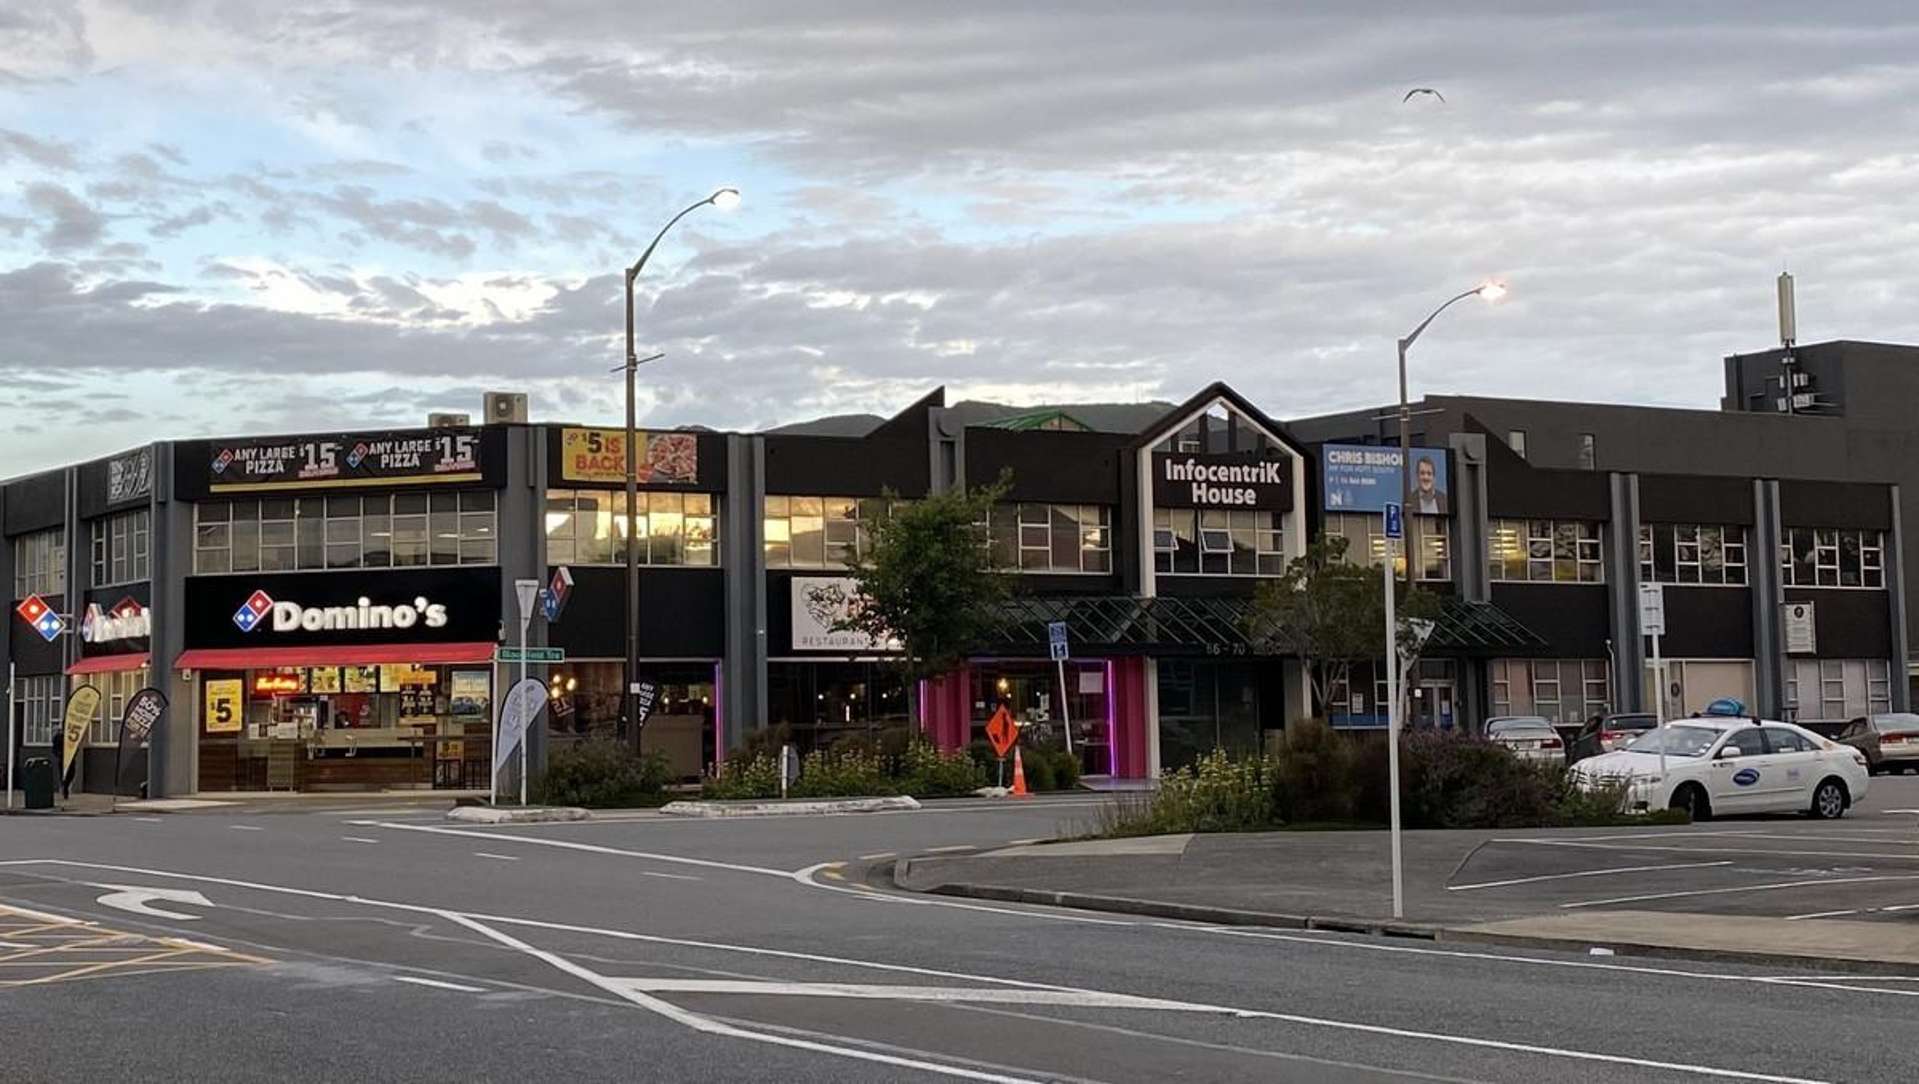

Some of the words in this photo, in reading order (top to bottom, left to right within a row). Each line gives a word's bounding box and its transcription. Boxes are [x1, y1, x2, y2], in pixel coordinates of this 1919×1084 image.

[235, 449, 257, 460] ANY
[260, 446, 295, 459] LARGE
[369, 442, 392, 455] ANY
[395, 440, 431, 453] LARGE
[605, 439, 621, 454] IS
[381, 454, 420, 468] PIZZA
[576, 454, 625, 471] BACK
[1328, 450, 1363, 464] CHRIS
[1365, 452, 1404, 466] BISHO
[246, 460, 284, 474] PIZZA
[1165, 458, 1281, 483] InfocentriK
[1192, 483, 1256, 505] House
[273, 597, 448, 632] Domino's
